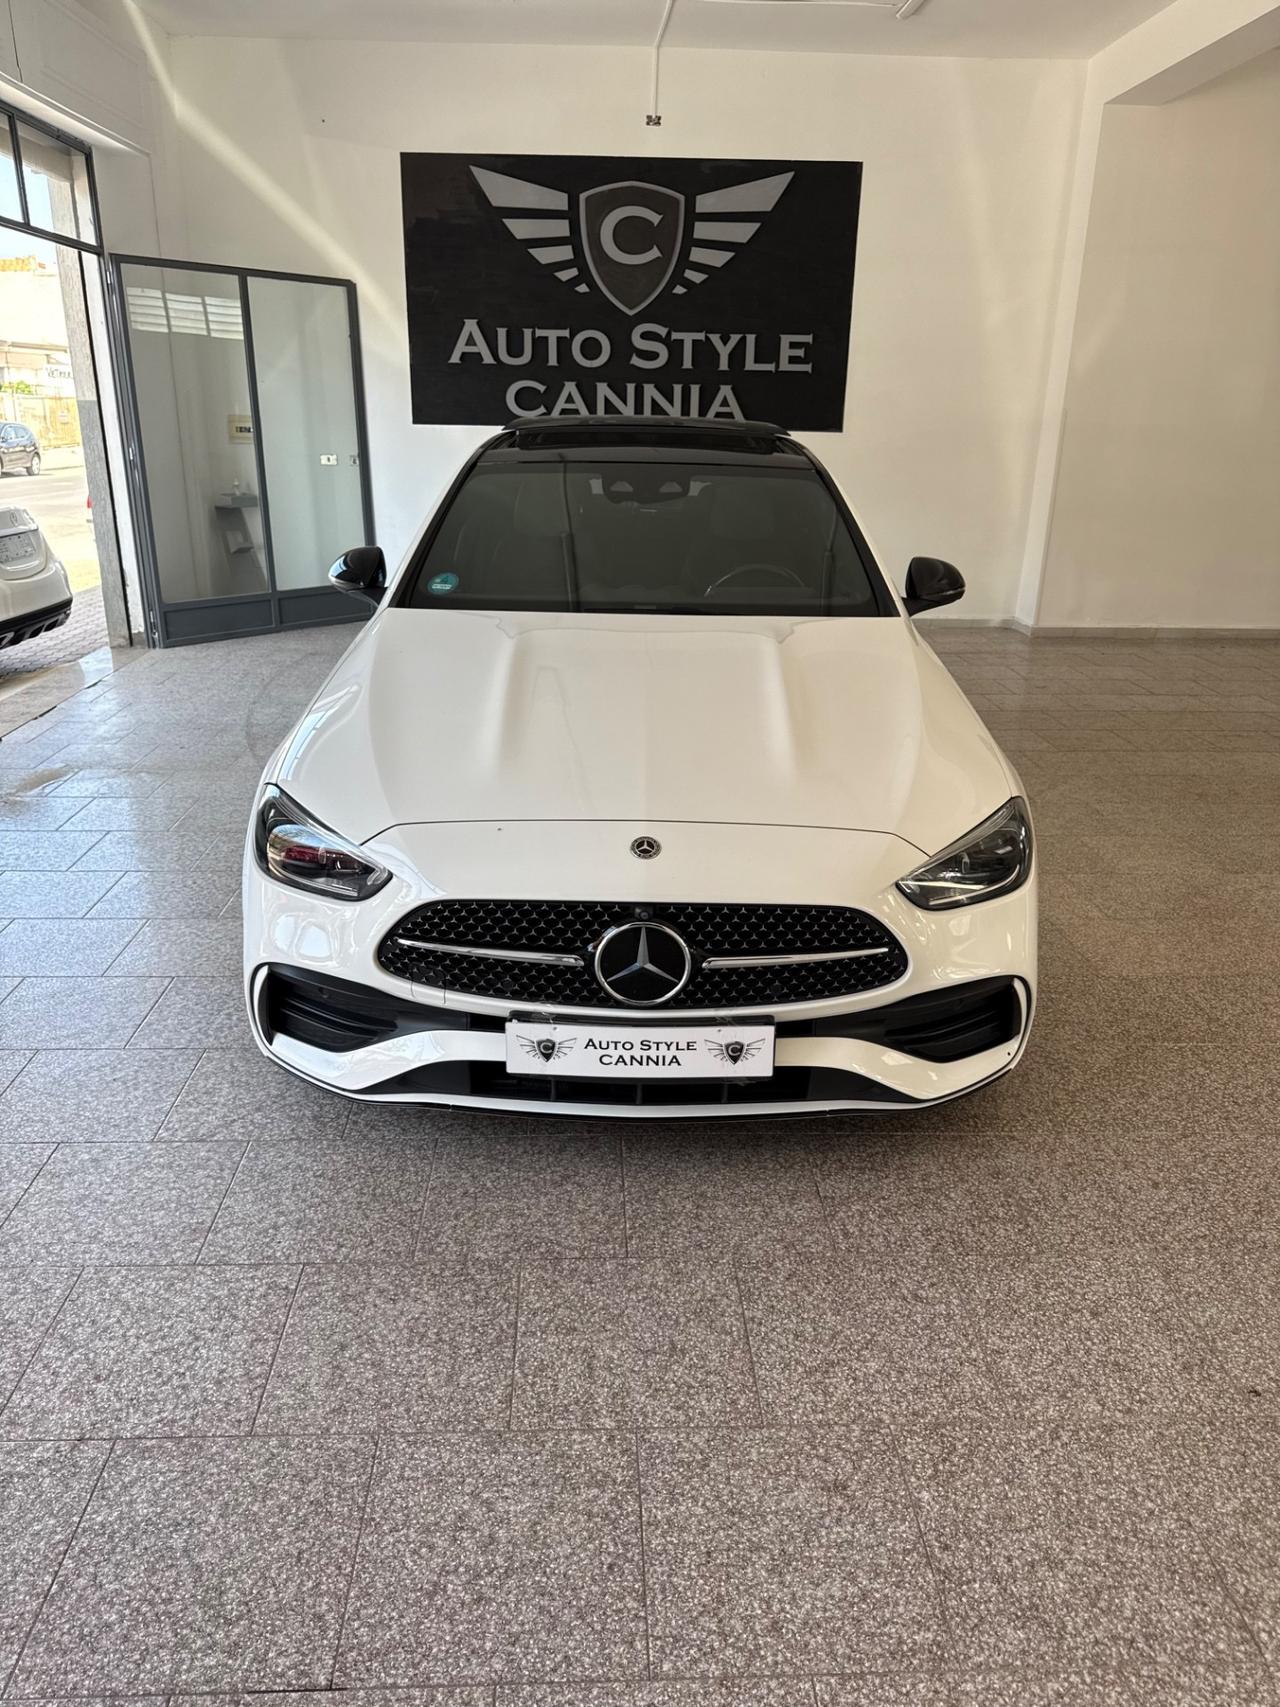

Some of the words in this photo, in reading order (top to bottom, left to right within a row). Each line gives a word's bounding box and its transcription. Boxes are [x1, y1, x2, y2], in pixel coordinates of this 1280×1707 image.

[599, 204, 664, 265] C
[447, 319, 612, 368] AUTO
[629, 322, 814, 374] STYLE
[505, 379, 746, 422] CANNIA
[540, 1042, 553, 1054] C
[583, 1038, 635, 1051] AUTO
[639, 1039, 698, 1052] STYLE
[728, 1044, 741, 1056] C
[598, 1054, 682, 1067] CANNIA
